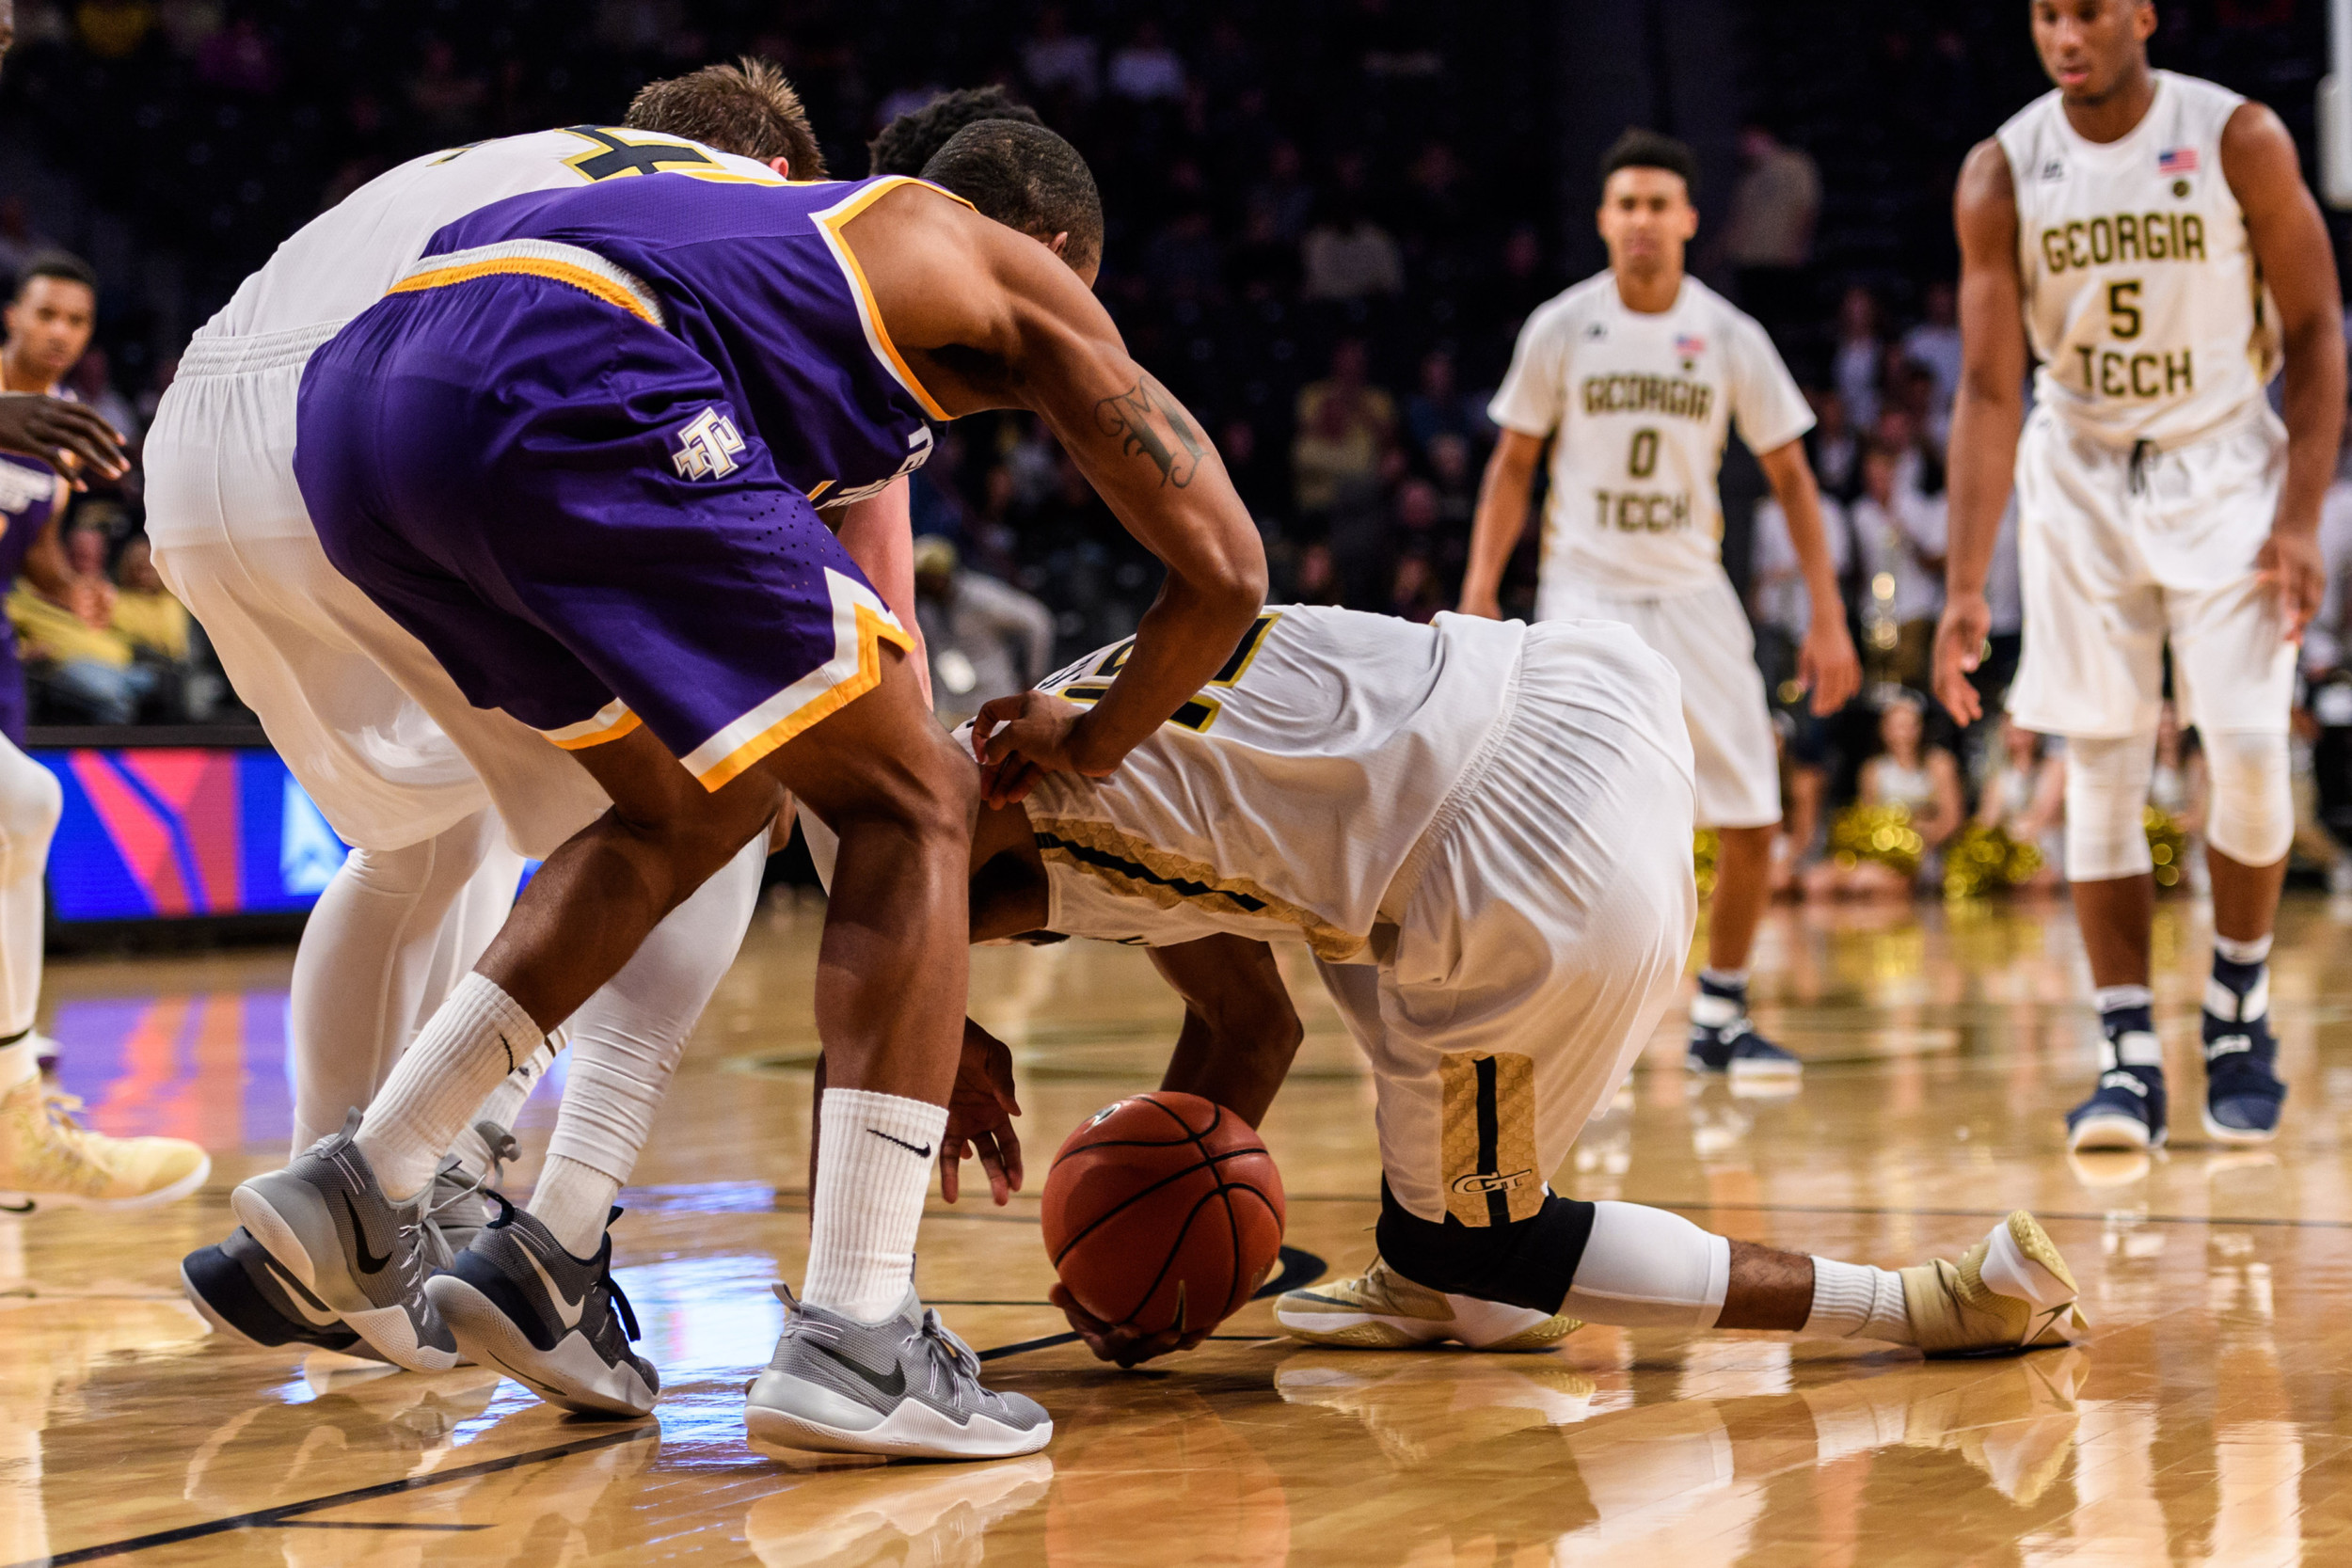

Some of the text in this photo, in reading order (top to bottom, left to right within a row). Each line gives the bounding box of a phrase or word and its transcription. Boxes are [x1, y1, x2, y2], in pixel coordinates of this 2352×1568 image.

[2042, 212, 2207, 275] GEORGIA
[2107, 278, 2143, 342] 5
[2074, 344, 2194, 398] TECH
[1629, 427, 1659, 478] 0
